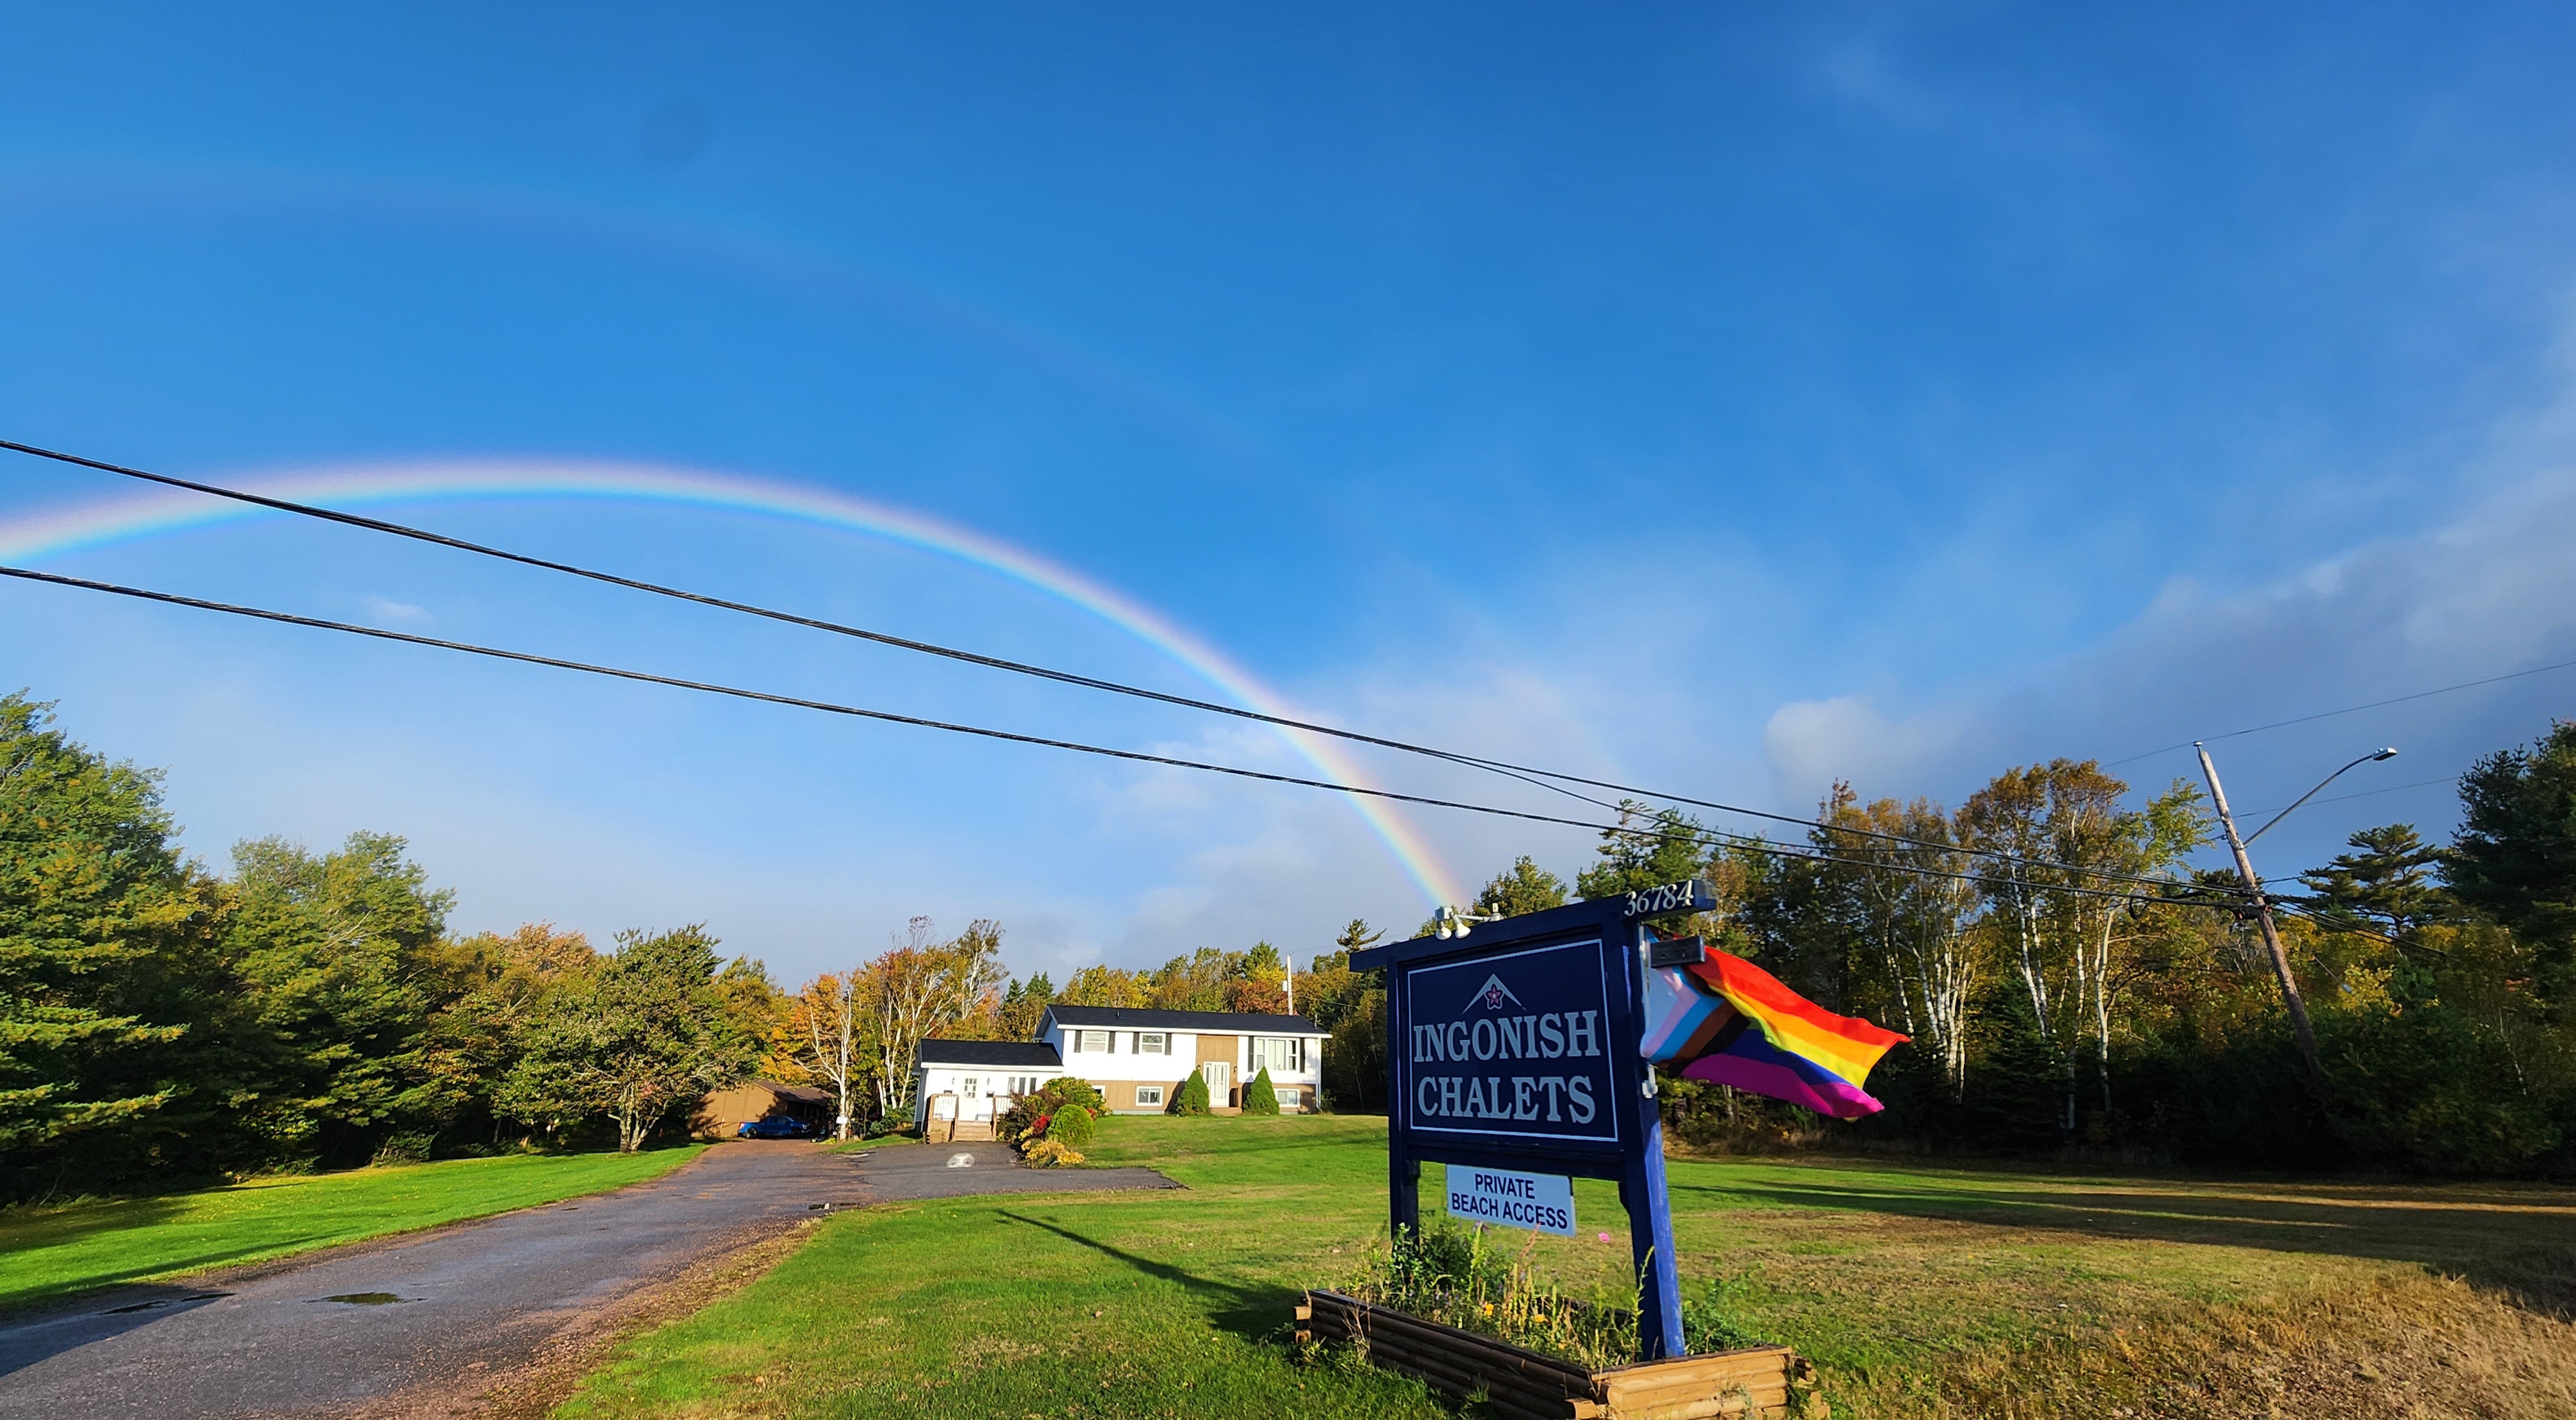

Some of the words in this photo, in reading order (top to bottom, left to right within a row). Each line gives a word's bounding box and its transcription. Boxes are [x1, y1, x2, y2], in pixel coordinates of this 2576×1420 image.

[1624, 880, 1694, 916] 36784
[1414, 1010, 1601, 1063] INGONISH
[1418, 1075, 1596, 1124] CHALETS
[1475, 1174, 1535, 1199] PRIVATE
[1452, 1193, 1499, 1217] BEACH
[1503, 1201, 1568, 1229] ACCESS
